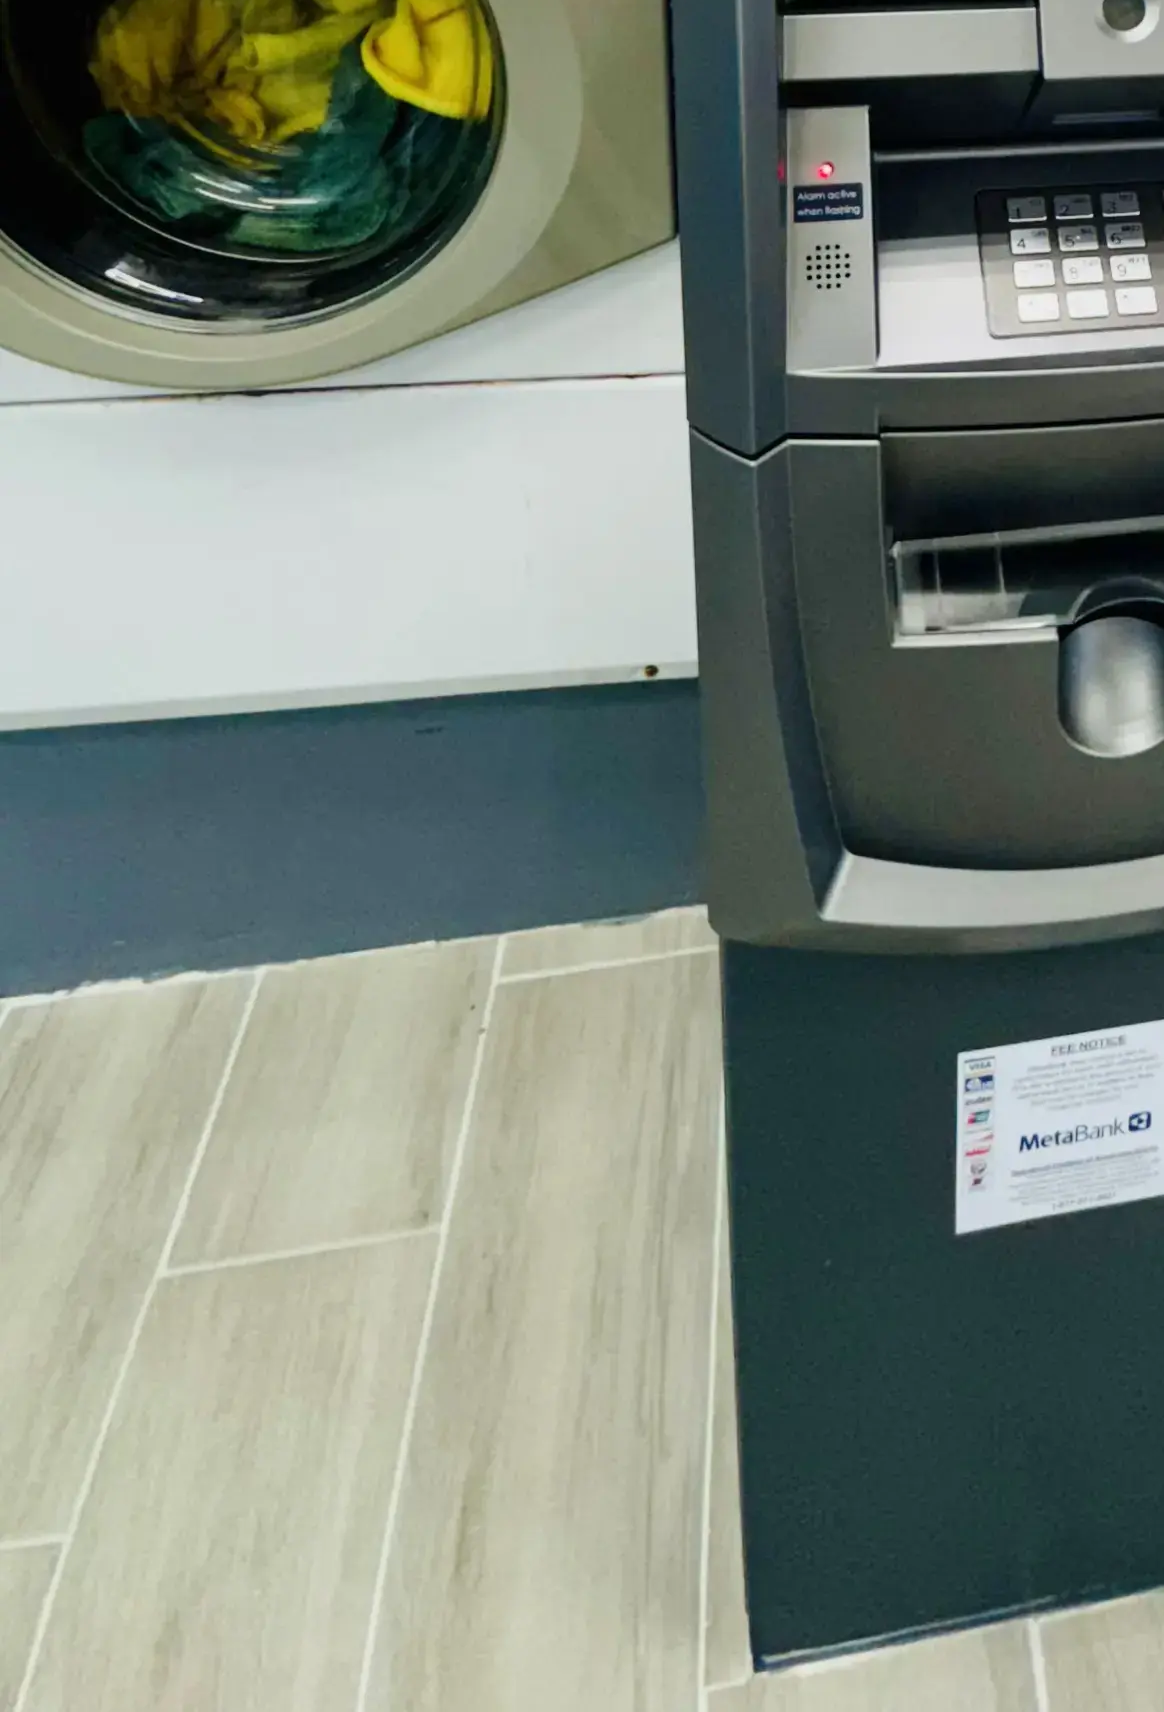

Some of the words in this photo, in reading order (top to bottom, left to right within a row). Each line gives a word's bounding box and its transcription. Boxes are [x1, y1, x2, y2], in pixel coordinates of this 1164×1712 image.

[797, 191, 825, 202] Alarm
[827, 189, 857, 200] active
[797, 206, 823, 216] when
[825, 204, 861, 216] flashing
[1017, 238, 1026, 249] 4
[1064, 235, 1075, 248] 5
[1110, 233, 1122, 246] 6
[1116, 263, 1127, 277] 9
[1051, 1044, 1076, 1057] FEE
[1079, 1035, 1126, 1052] NOTICE
[1019, 1117, 1125, 1153] MetaBank
